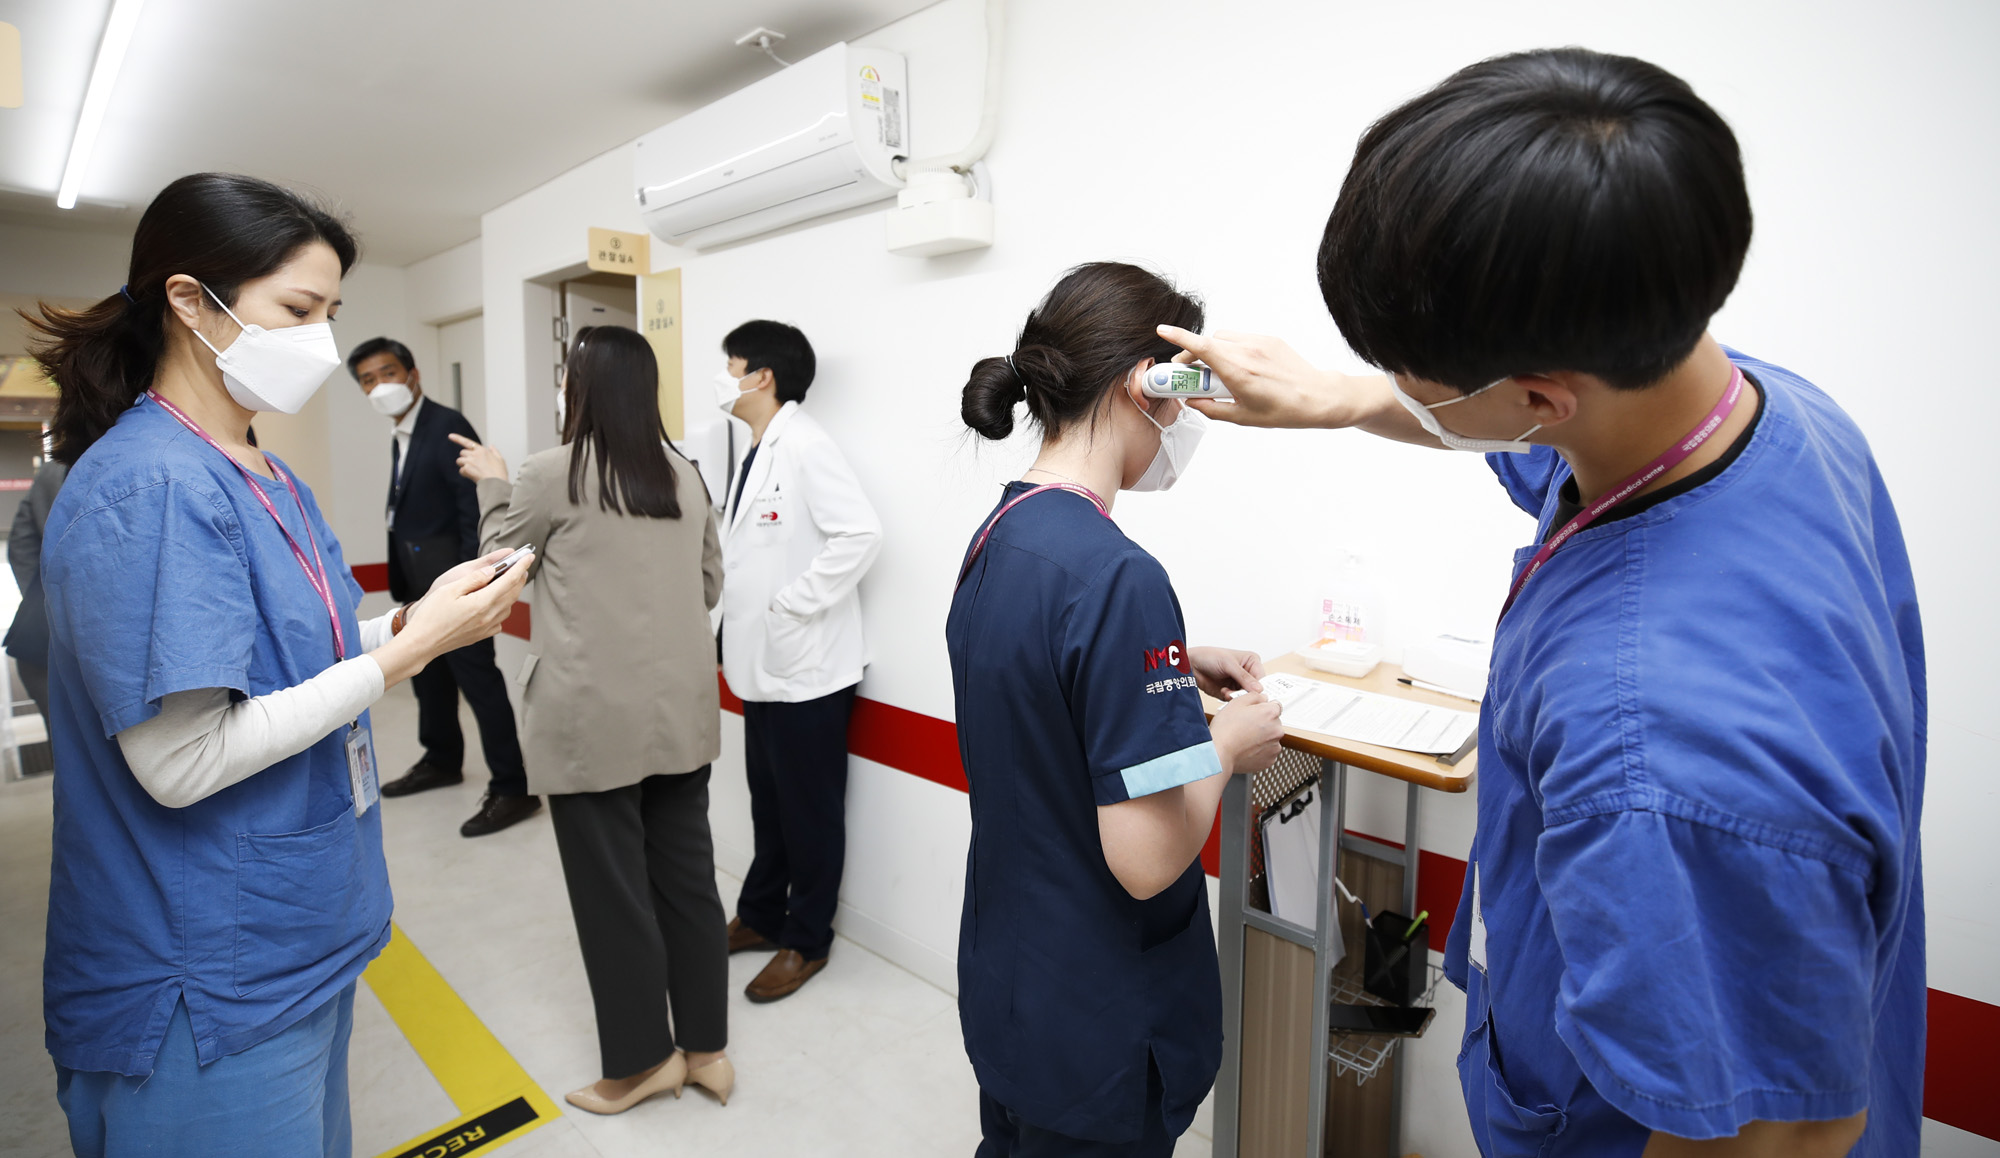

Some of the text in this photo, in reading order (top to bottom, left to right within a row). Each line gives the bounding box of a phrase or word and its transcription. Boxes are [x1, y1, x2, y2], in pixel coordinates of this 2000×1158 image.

[1592, 464, 1665, 515] national medical center
[1144, 645, 1180, 672] NMC
[413, 1125, 486, 1158] REC
